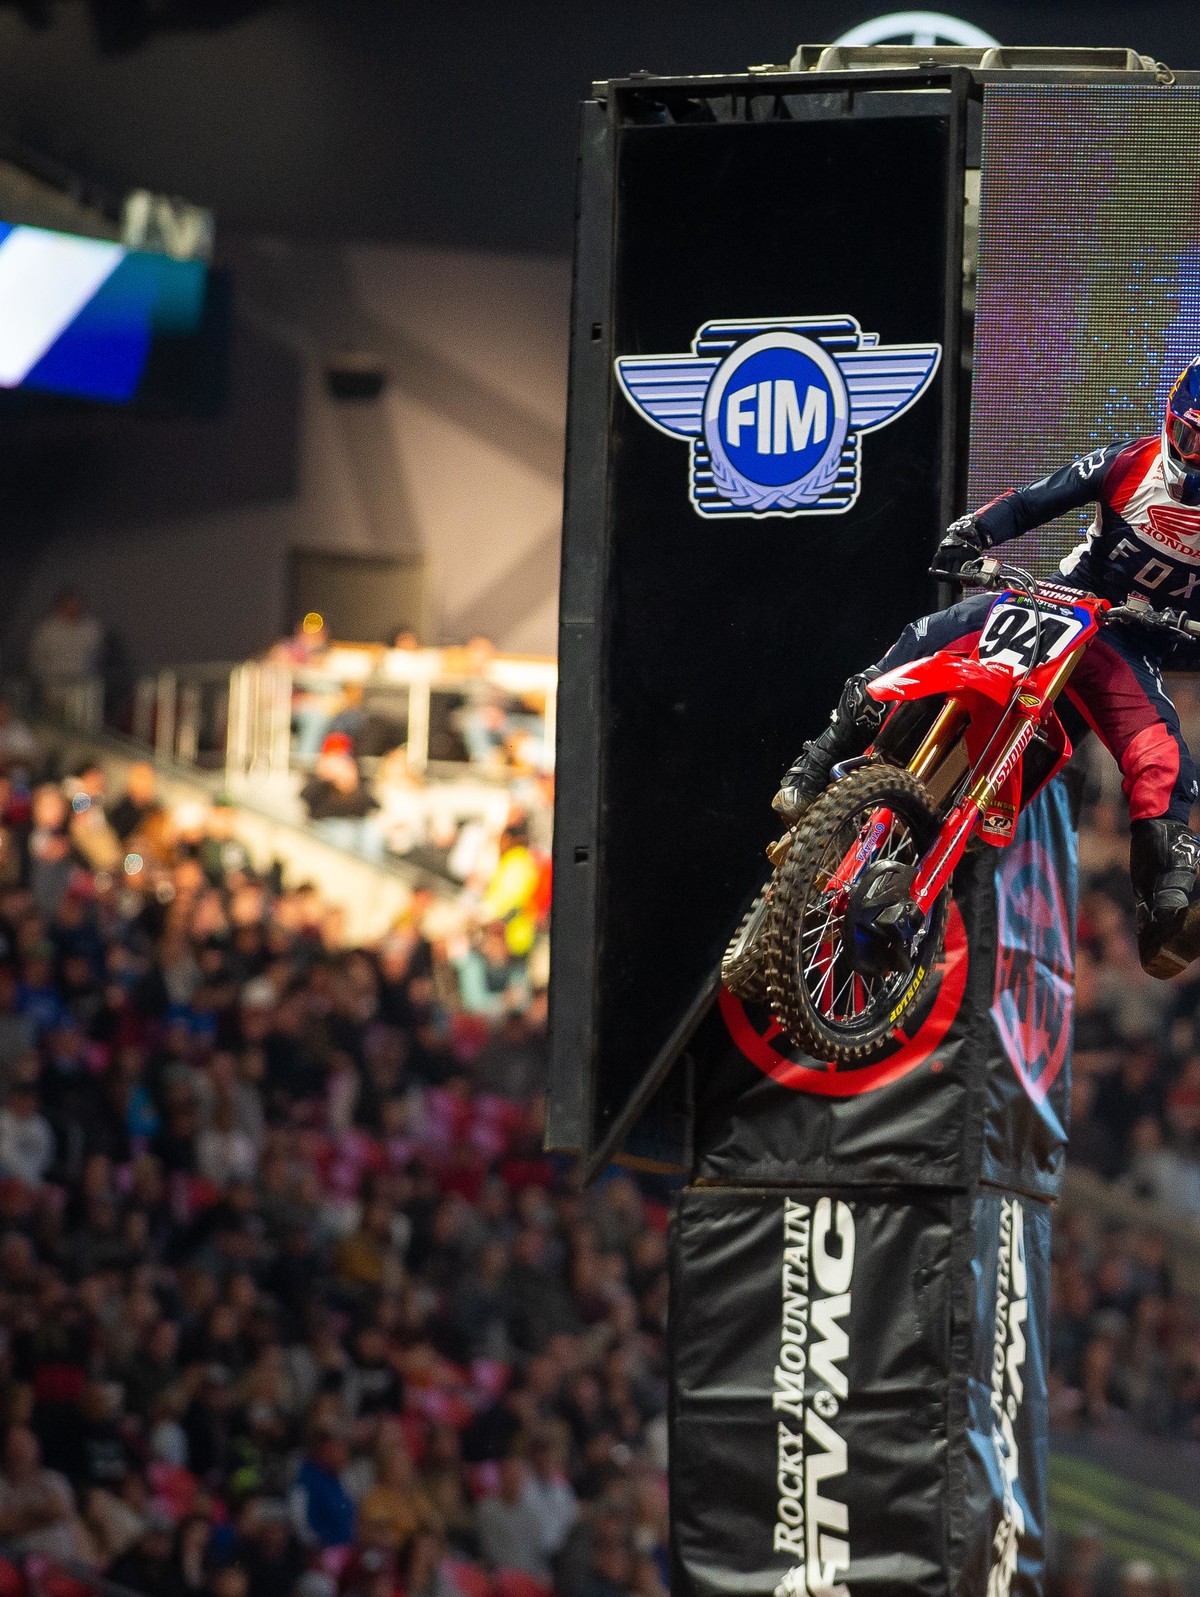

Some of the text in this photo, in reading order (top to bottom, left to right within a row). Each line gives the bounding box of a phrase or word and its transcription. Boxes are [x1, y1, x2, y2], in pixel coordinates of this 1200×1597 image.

[726, 379, 828, 456] FIM
[1023, 597, 1058, 611] MNSTER
[1028, 586, 1079, 604] RNTHAL
[979, 608, 1071, 669] 94
[995, 723, 1035, 785] SHOWA
[889, 965, 926, 1023] DUNLOP
[772, 1196, 812, 1558] ROCKY MOUNTAIN
